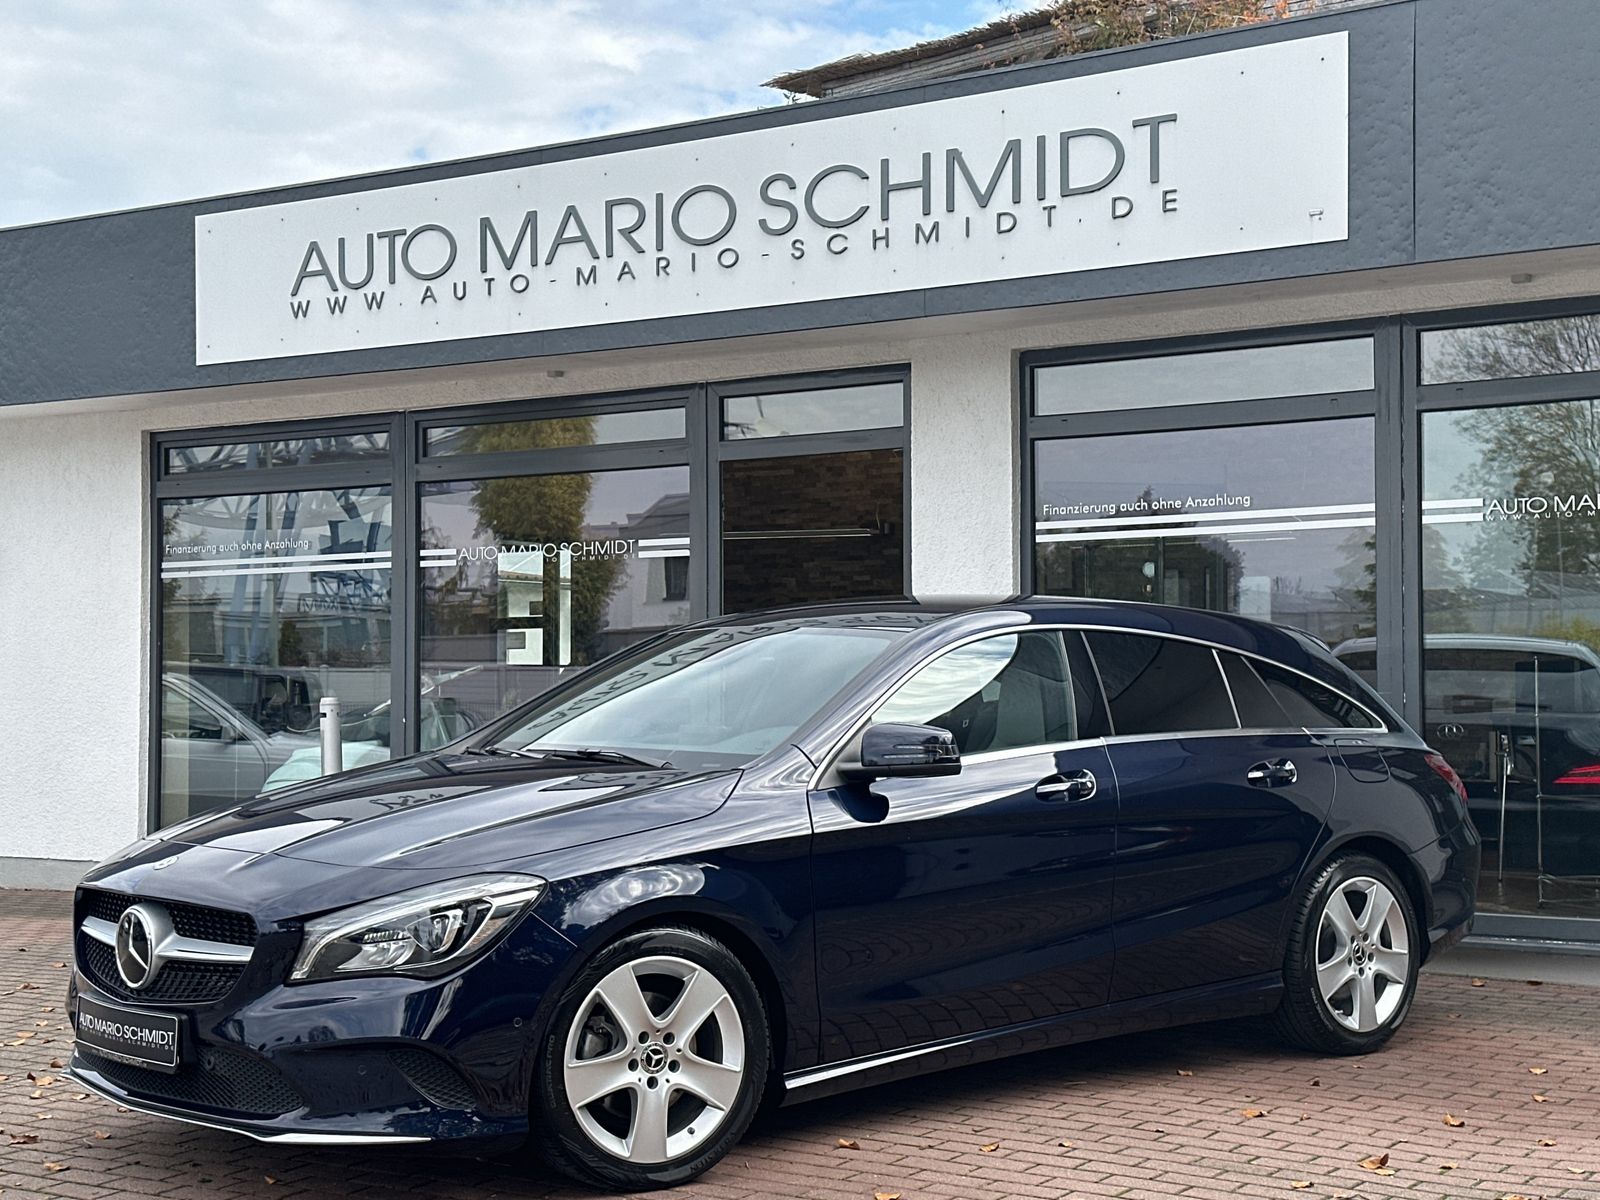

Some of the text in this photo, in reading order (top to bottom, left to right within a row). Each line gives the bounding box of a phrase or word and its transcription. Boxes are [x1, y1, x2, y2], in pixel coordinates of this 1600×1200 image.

[290, 113, 1178, 297] AUTO MARIO SCHMIDT
[289, 188, 1178, 320] WWW.AUTO-MARIO-SCHMIDT.DE
[1042, 493, 1251, 516] Finanzierung auch ohne Anzahlung
[1486, 493, 1600, 515] AUTO MA
[165, 538, 309, 556] Finanzierung auch ohne Anzahlung
[457, 546, 498, 561] AUTO
[560, 539, 636, 556] SCHMIDT
[79, 1011, 175, 1046] AUTO MARIO SCHMIDT
